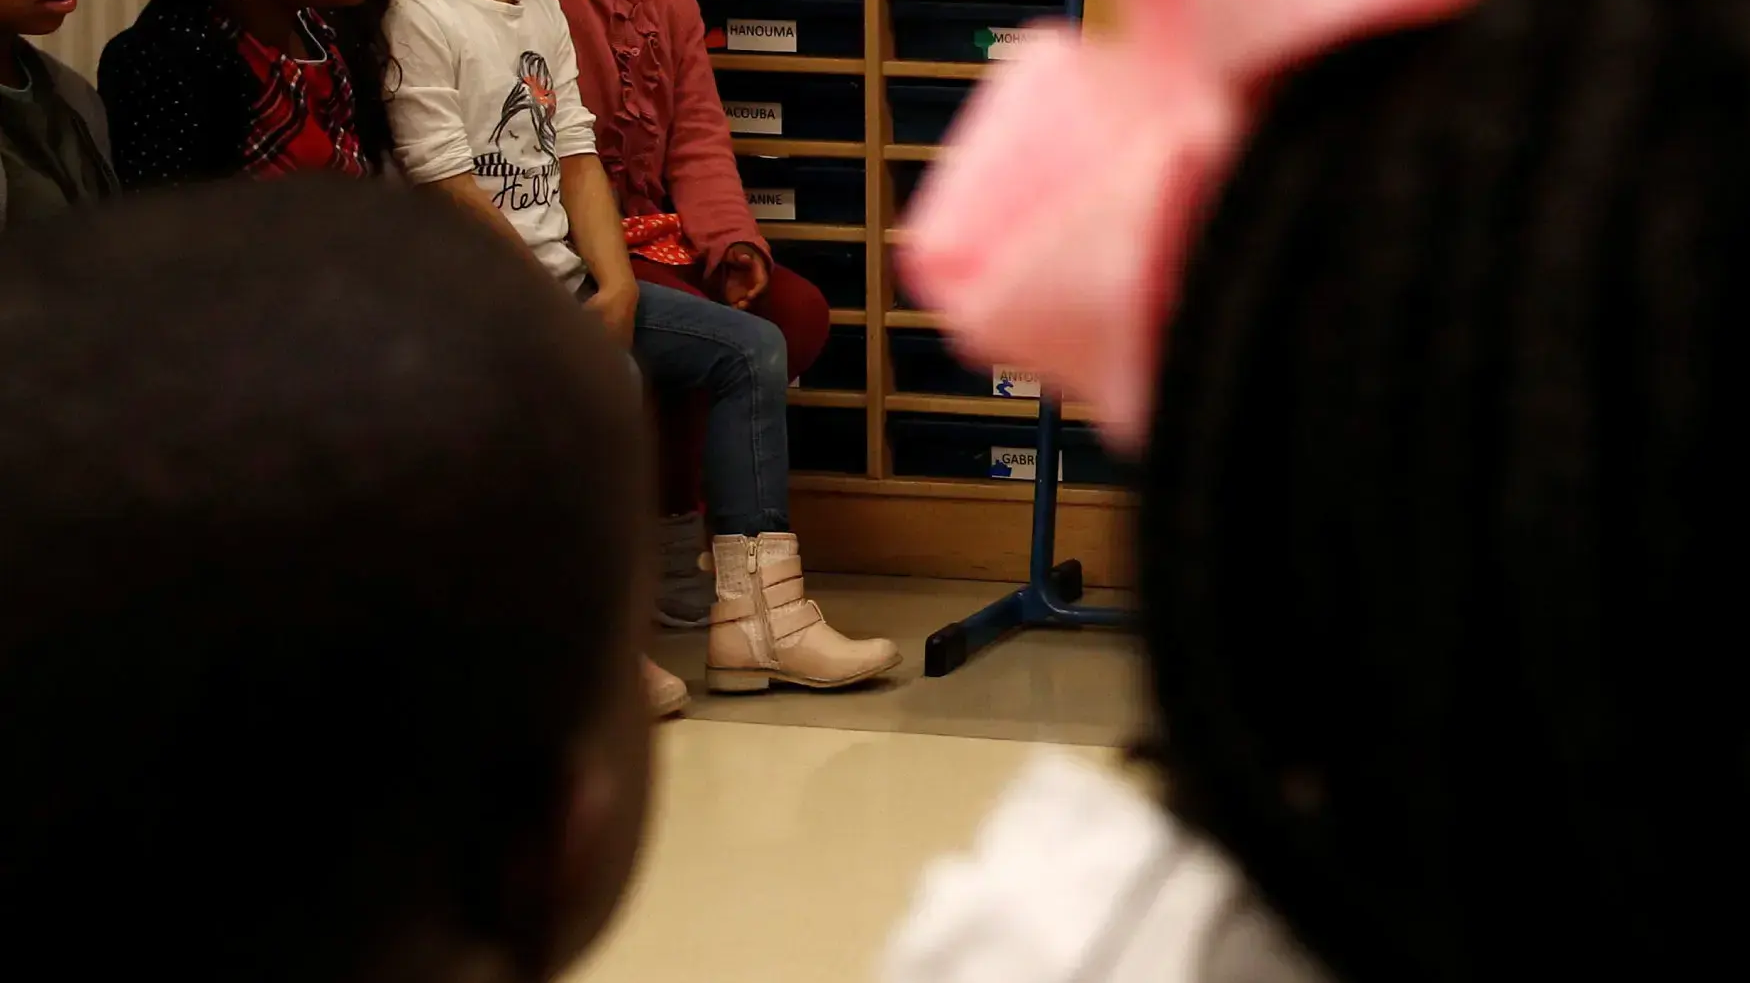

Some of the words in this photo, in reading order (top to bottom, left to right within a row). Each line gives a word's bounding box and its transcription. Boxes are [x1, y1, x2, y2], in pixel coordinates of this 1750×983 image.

[730, 25, 794, 38] HANOUMA
[994, 33, 1027, 43] MOHA
[1000, 370, 1040, 382] ANTO
[1002, 453, 1035, 465] GABR
